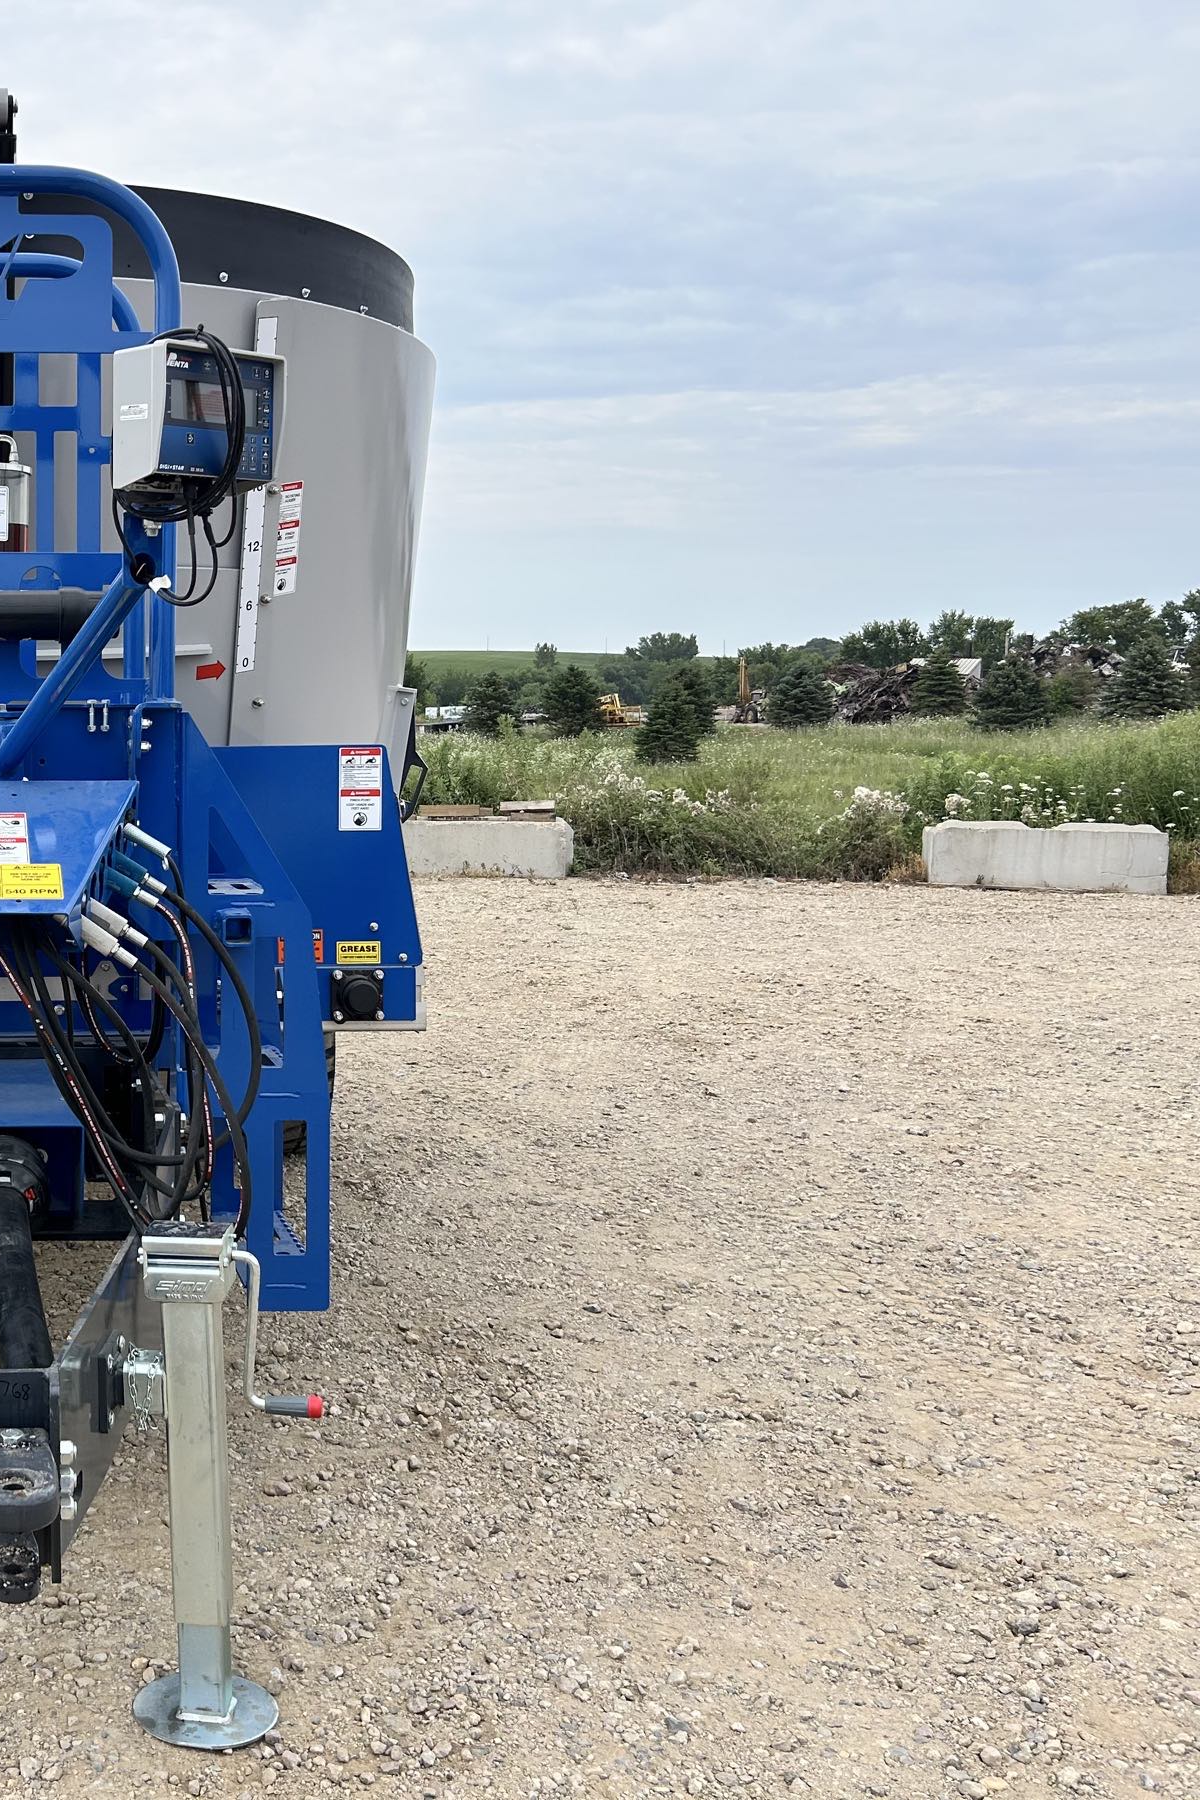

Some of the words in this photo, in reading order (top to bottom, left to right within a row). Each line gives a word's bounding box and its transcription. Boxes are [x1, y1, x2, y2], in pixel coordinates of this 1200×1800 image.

[166, 352, 189, 369] PENTA
[247, 541, 260, 552] 12
[245, 600, 253, 611] 6
[242, 657, 249, 668] 0
[340, 945, 377, 953] GREASE
